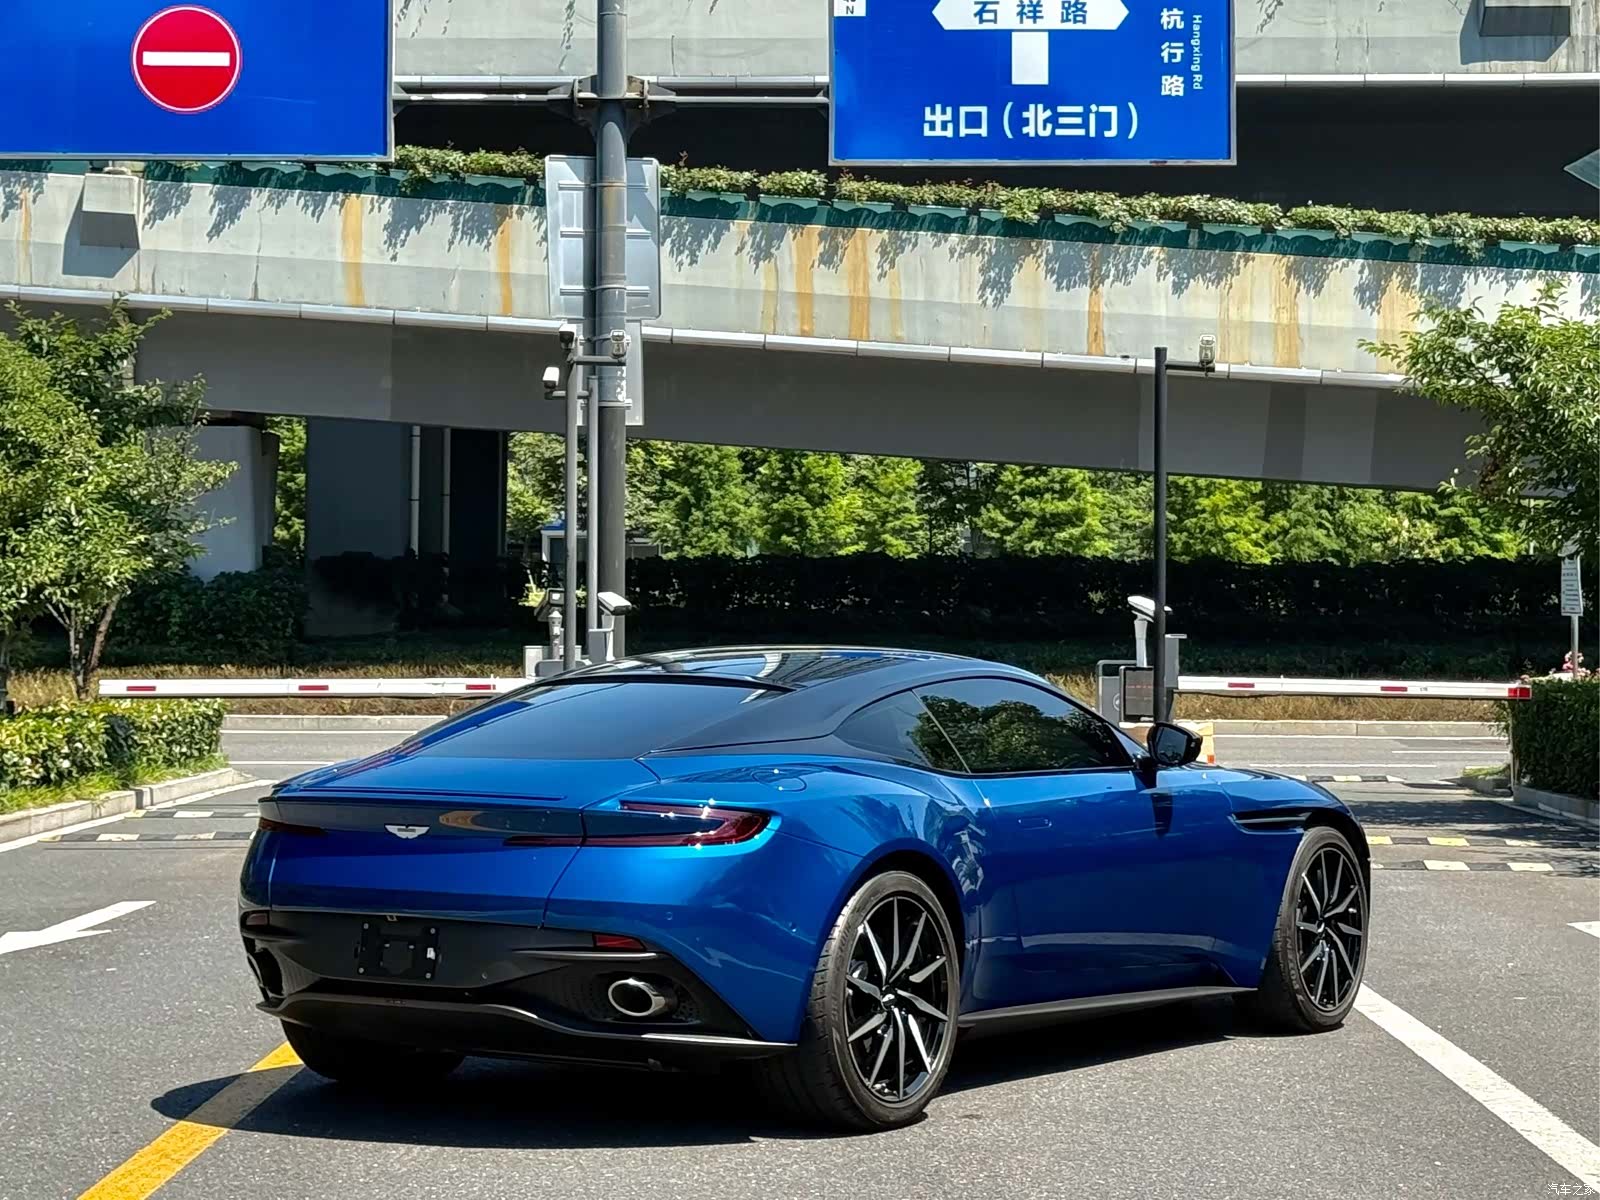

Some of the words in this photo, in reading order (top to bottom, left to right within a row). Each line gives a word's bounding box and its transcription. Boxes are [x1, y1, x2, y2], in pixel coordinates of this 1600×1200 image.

[845, 5, 855, 15] N
[973, 0, 1088, 25] 石祥路
[1160, 7, 1185, 97] 杭行路
[1190, 14, 1203, 72] Hangxing
[1192, 74, 1204, 90] Rd
